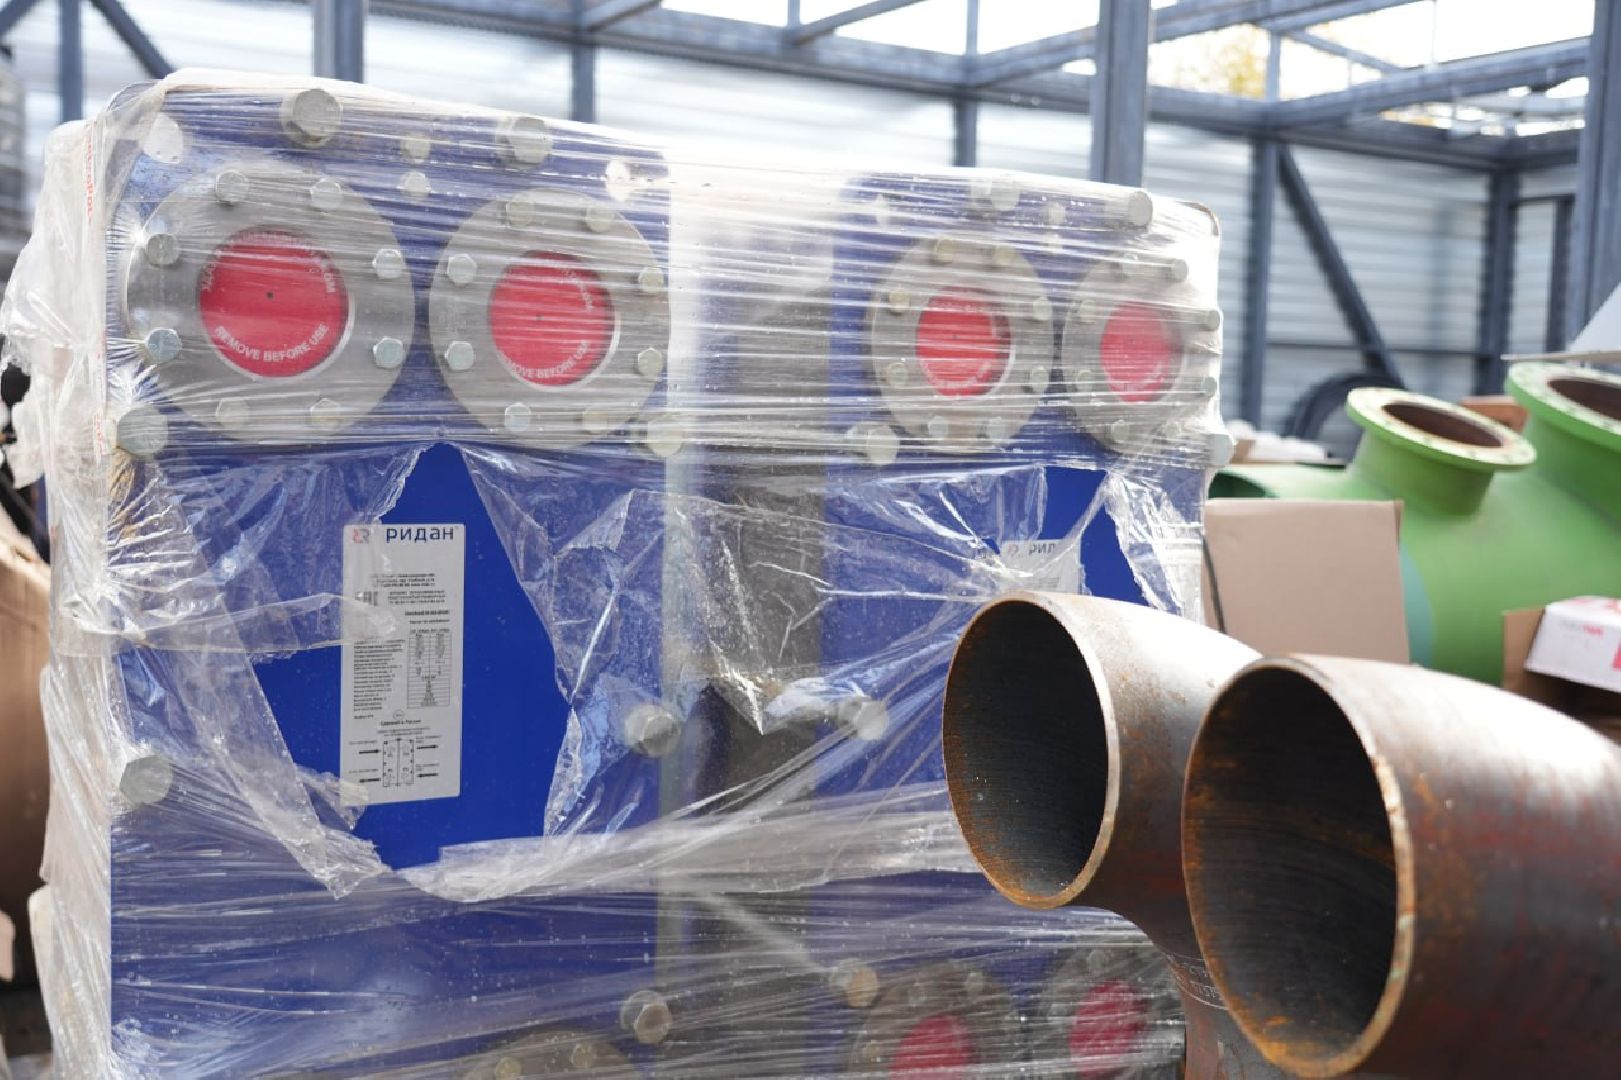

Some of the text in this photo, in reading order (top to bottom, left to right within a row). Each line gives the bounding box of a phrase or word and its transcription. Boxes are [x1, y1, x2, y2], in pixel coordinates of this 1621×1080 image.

[215, 323, 329, 363] REMOVE BEFORE USE
